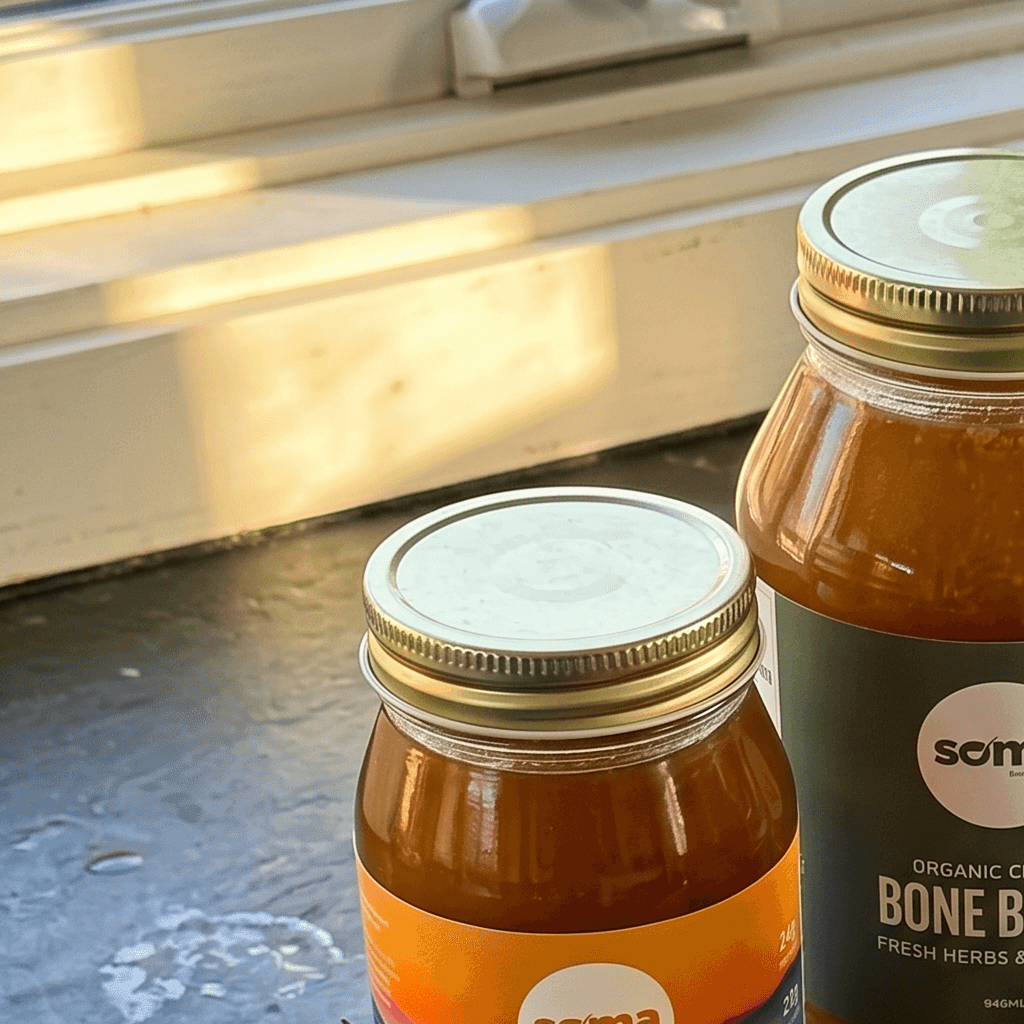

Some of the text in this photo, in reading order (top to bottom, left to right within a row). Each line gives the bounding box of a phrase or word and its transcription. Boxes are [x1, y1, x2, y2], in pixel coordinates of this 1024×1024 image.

[913, 859, 1002, 879] ORGANIC
[878, 874, 986, 938] BONE
[877, 935, 936, 961] FRESH
[943, 948, 1009, 965] HERBS
